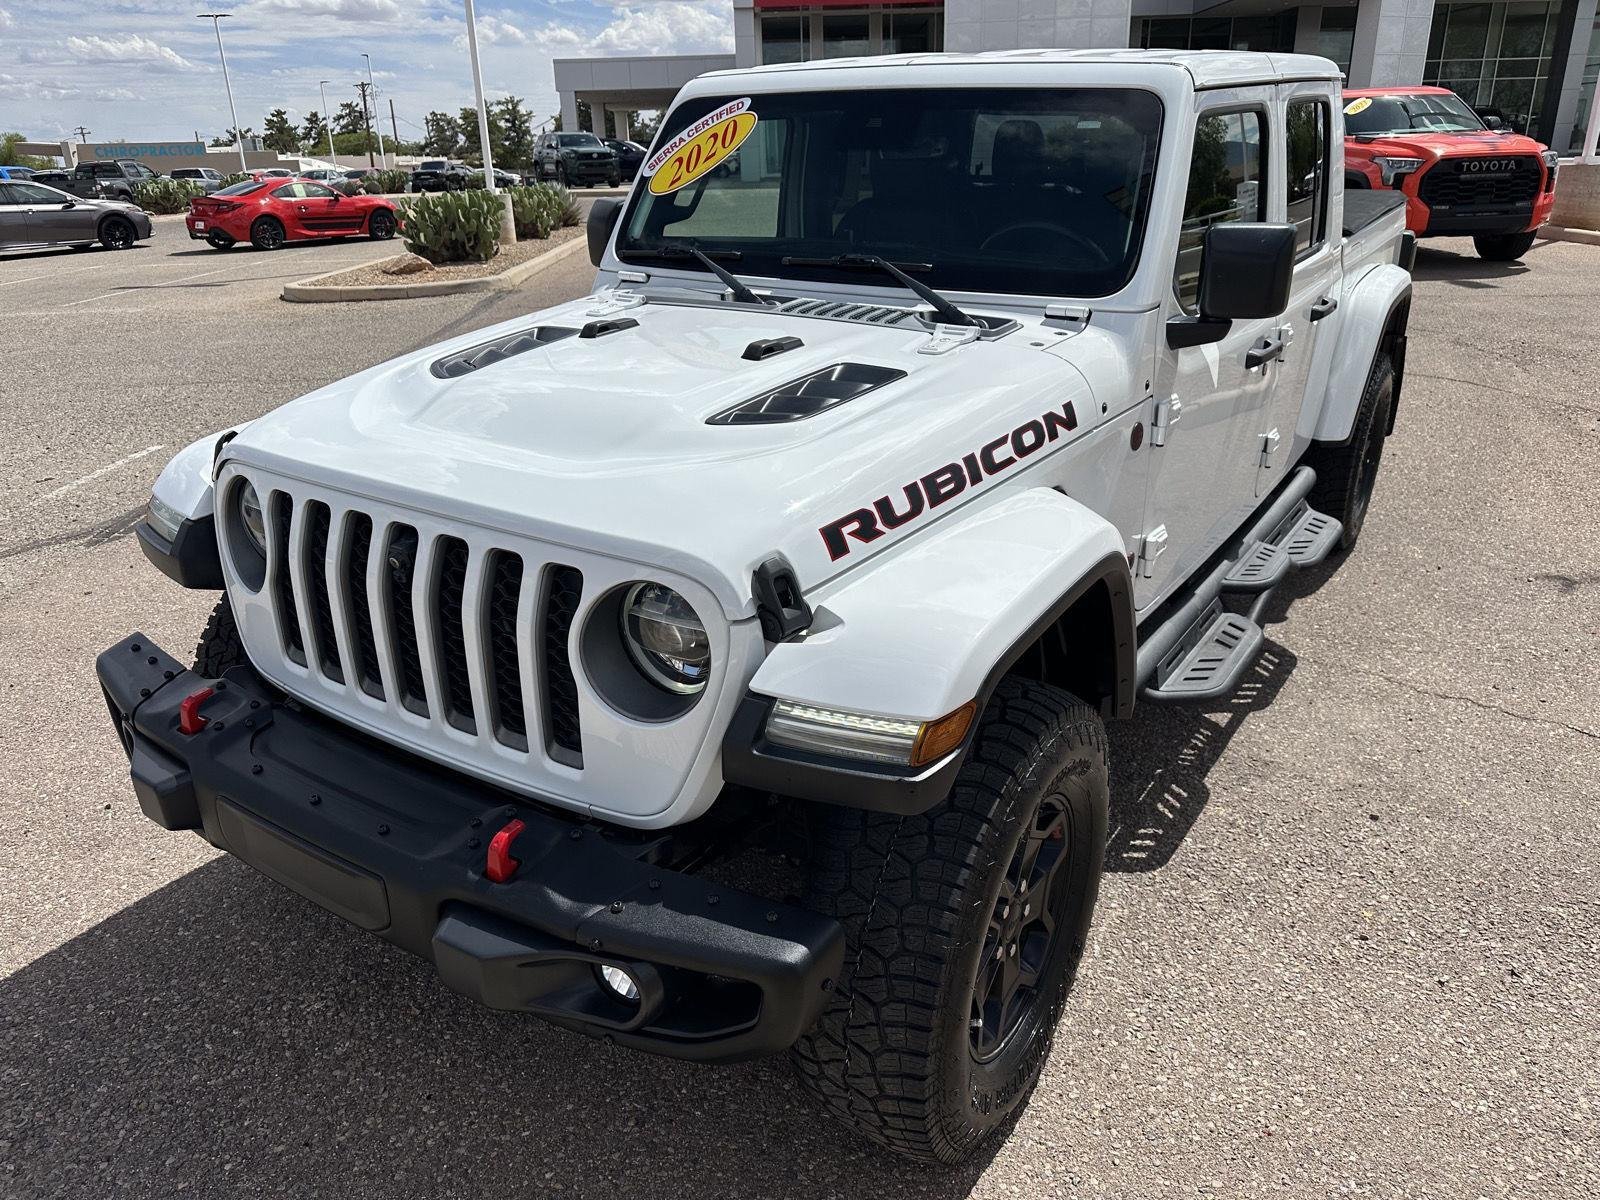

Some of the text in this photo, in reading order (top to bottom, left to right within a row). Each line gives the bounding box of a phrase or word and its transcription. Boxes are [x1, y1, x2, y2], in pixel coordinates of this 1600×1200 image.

[95, 144, 205, 157] CHIROPRACTOR
[647, 100, 745, 171] SIERRA CERTIFIED
[667, 119, 738, 188] 2020
[1461, 160, 1516, 171] TOYOTA
[818, 399, 1079, 563] RUBICON
